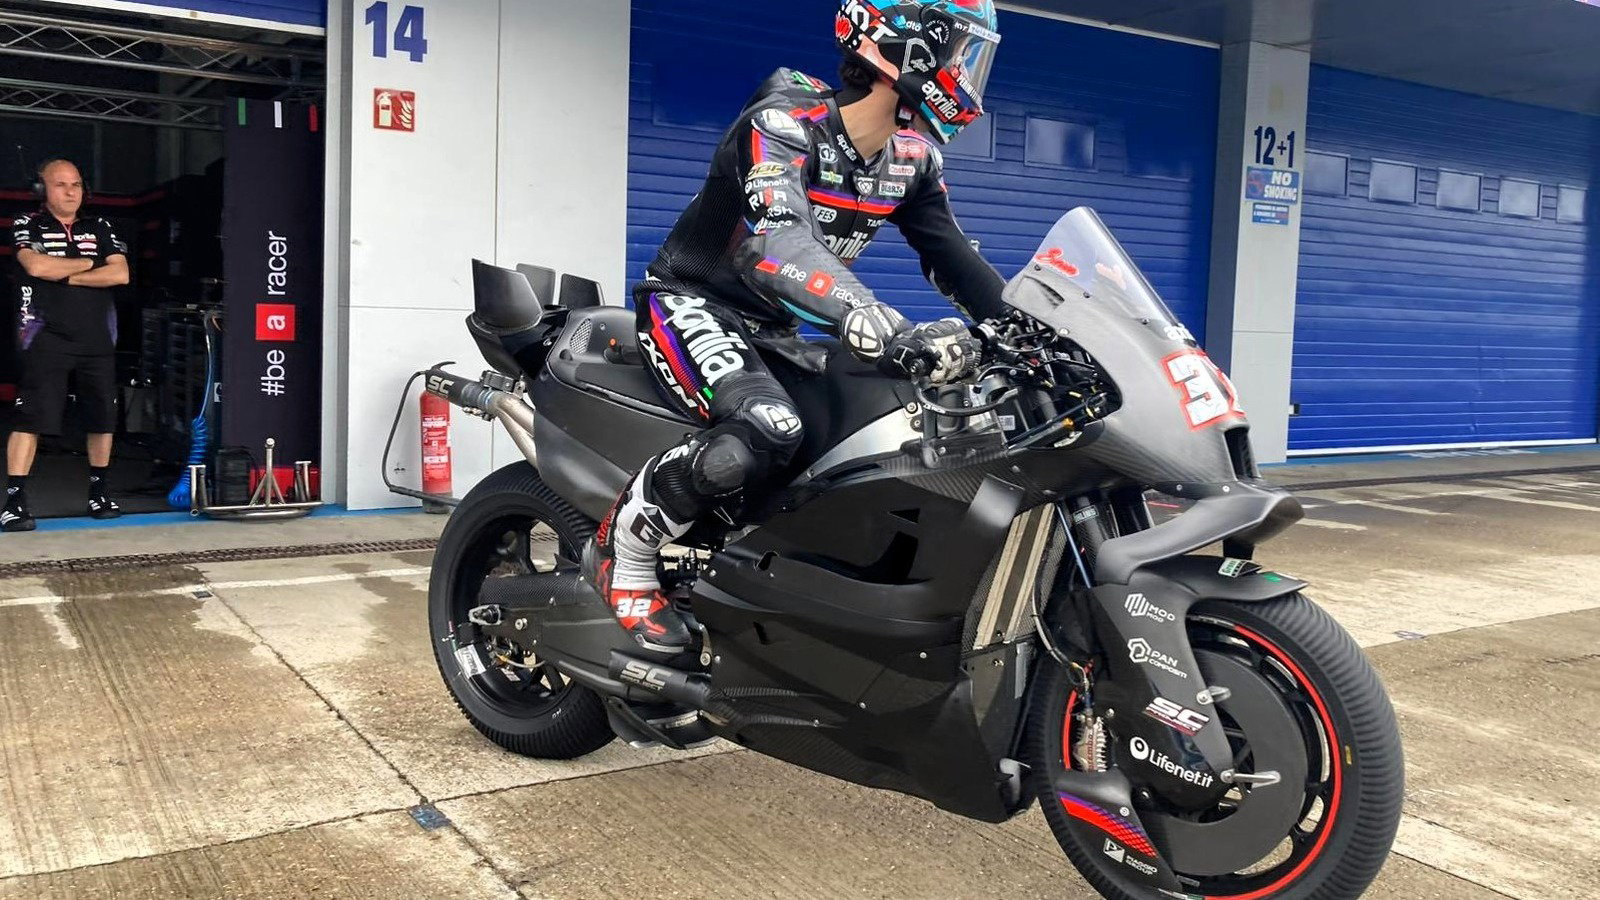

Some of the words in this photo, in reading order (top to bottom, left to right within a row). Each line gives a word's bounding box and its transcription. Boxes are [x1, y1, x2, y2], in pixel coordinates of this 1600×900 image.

[366, 1, 428, 62] 14
[921, 80, 958, 119] aprilia
[1254, 126, 1295, 168] 12+1
[1271, 171, 1292, 185] NO
[1263, 184, 1297, 201] SMOKING
[267, 230, 288, 296] racer
[780, 262, 807, 282] #be
[266, 313, 287, 332] a
[663, 294, 749, 386] aprilia
[261, 349, 286, 396] #be
[427, 375, 454, 394] SC
[616, 598, 652, 618] 32
[1148, 604, 1176, 621] MOD
[1151, 650, 1179, 667] PAN
[621, 661, 672, 687] SC
[1147, 697, 1210, 731] SC
[1149, 748, 1214, 788] Lifenet.it
